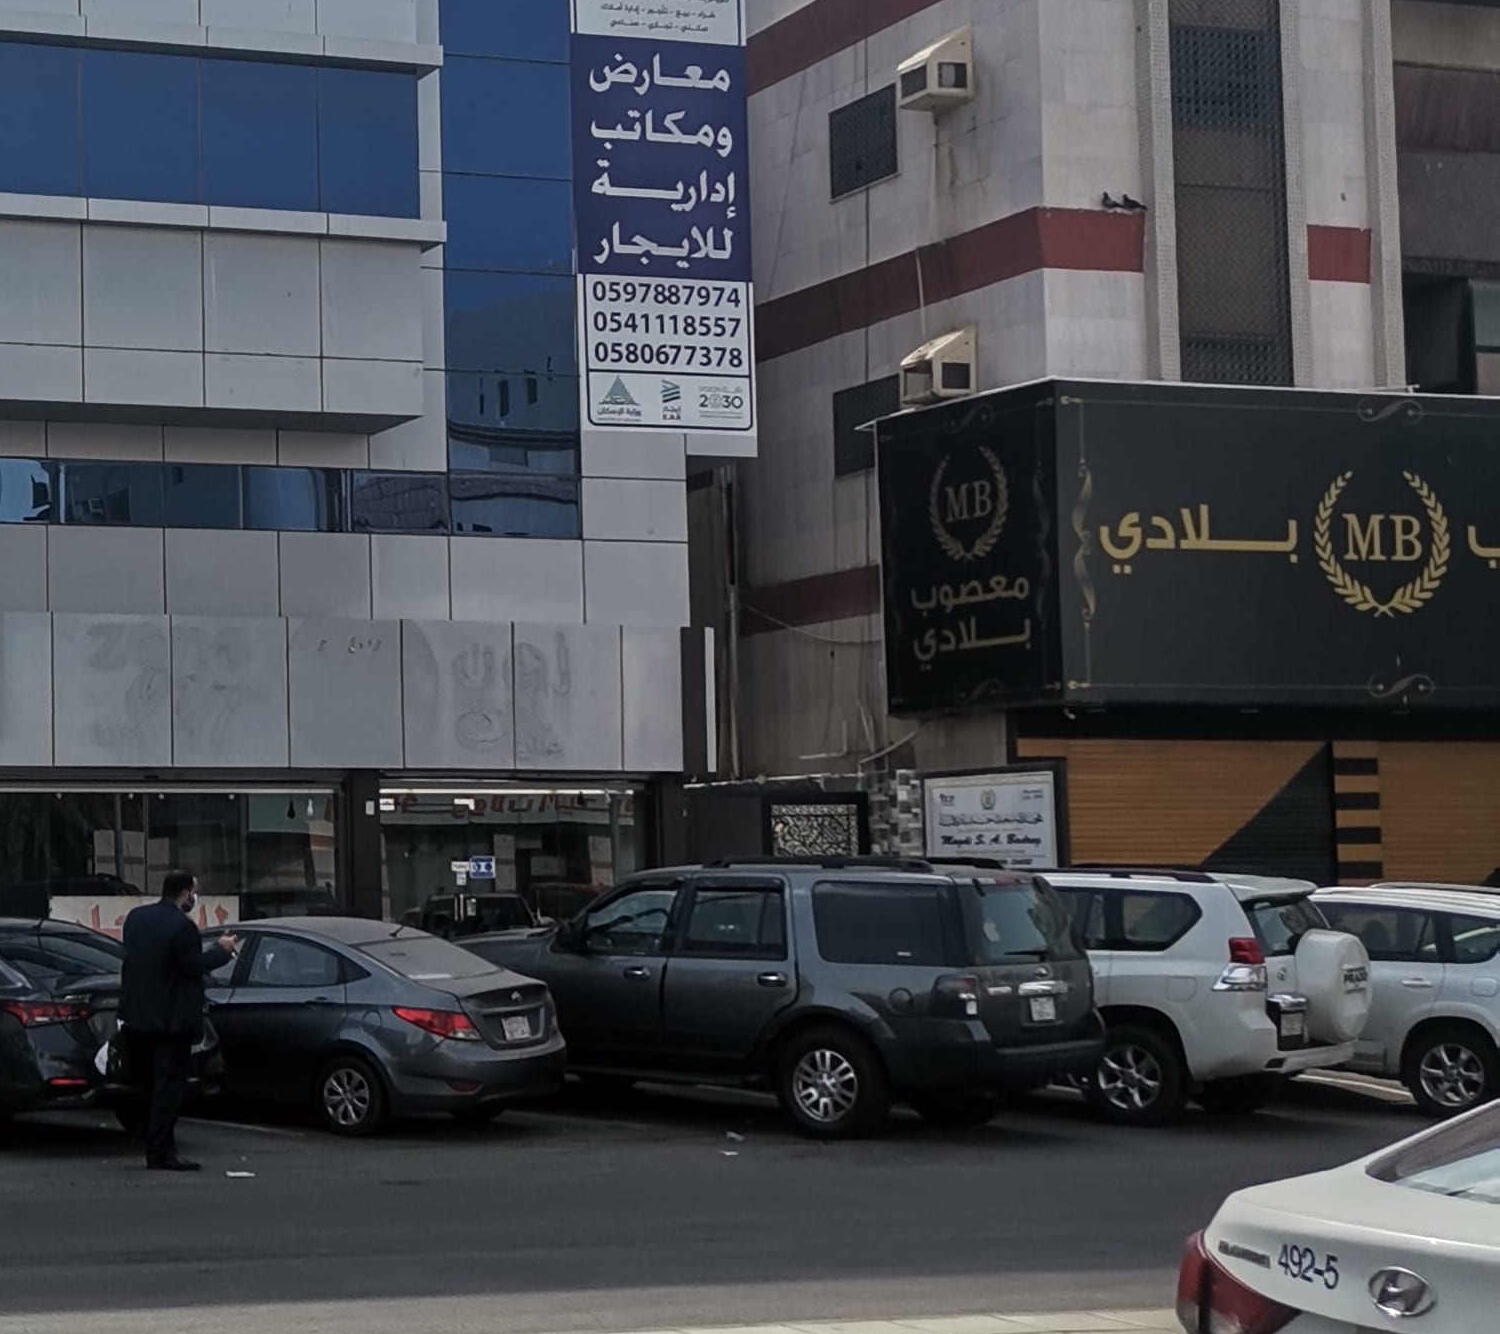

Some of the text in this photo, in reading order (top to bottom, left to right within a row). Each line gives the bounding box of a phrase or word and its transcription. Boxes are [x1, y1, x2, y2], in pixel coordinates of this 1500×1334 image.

[589, 53, 731, 95] معارض
[590, 109, 733, 157] ومكاتب
[591, 159, 736, 219] إدارية
[593, 221, 734, 269] للايجار
[592, 281, 741, 308] 0597887974
[593, 311, 742, 338] 0541118557
[594, 342, 743, 368] 0580677378
[945, 480, 992, 523] MB
[1100, 504, 1298, 574] بلادي
[1342, 513, 1423, 561] MB
[911, 575, 1029, 617] معصوب
[913, 616, 1031, 672] بلادي
[1278, 1243, 1339, 1290] 492-5
